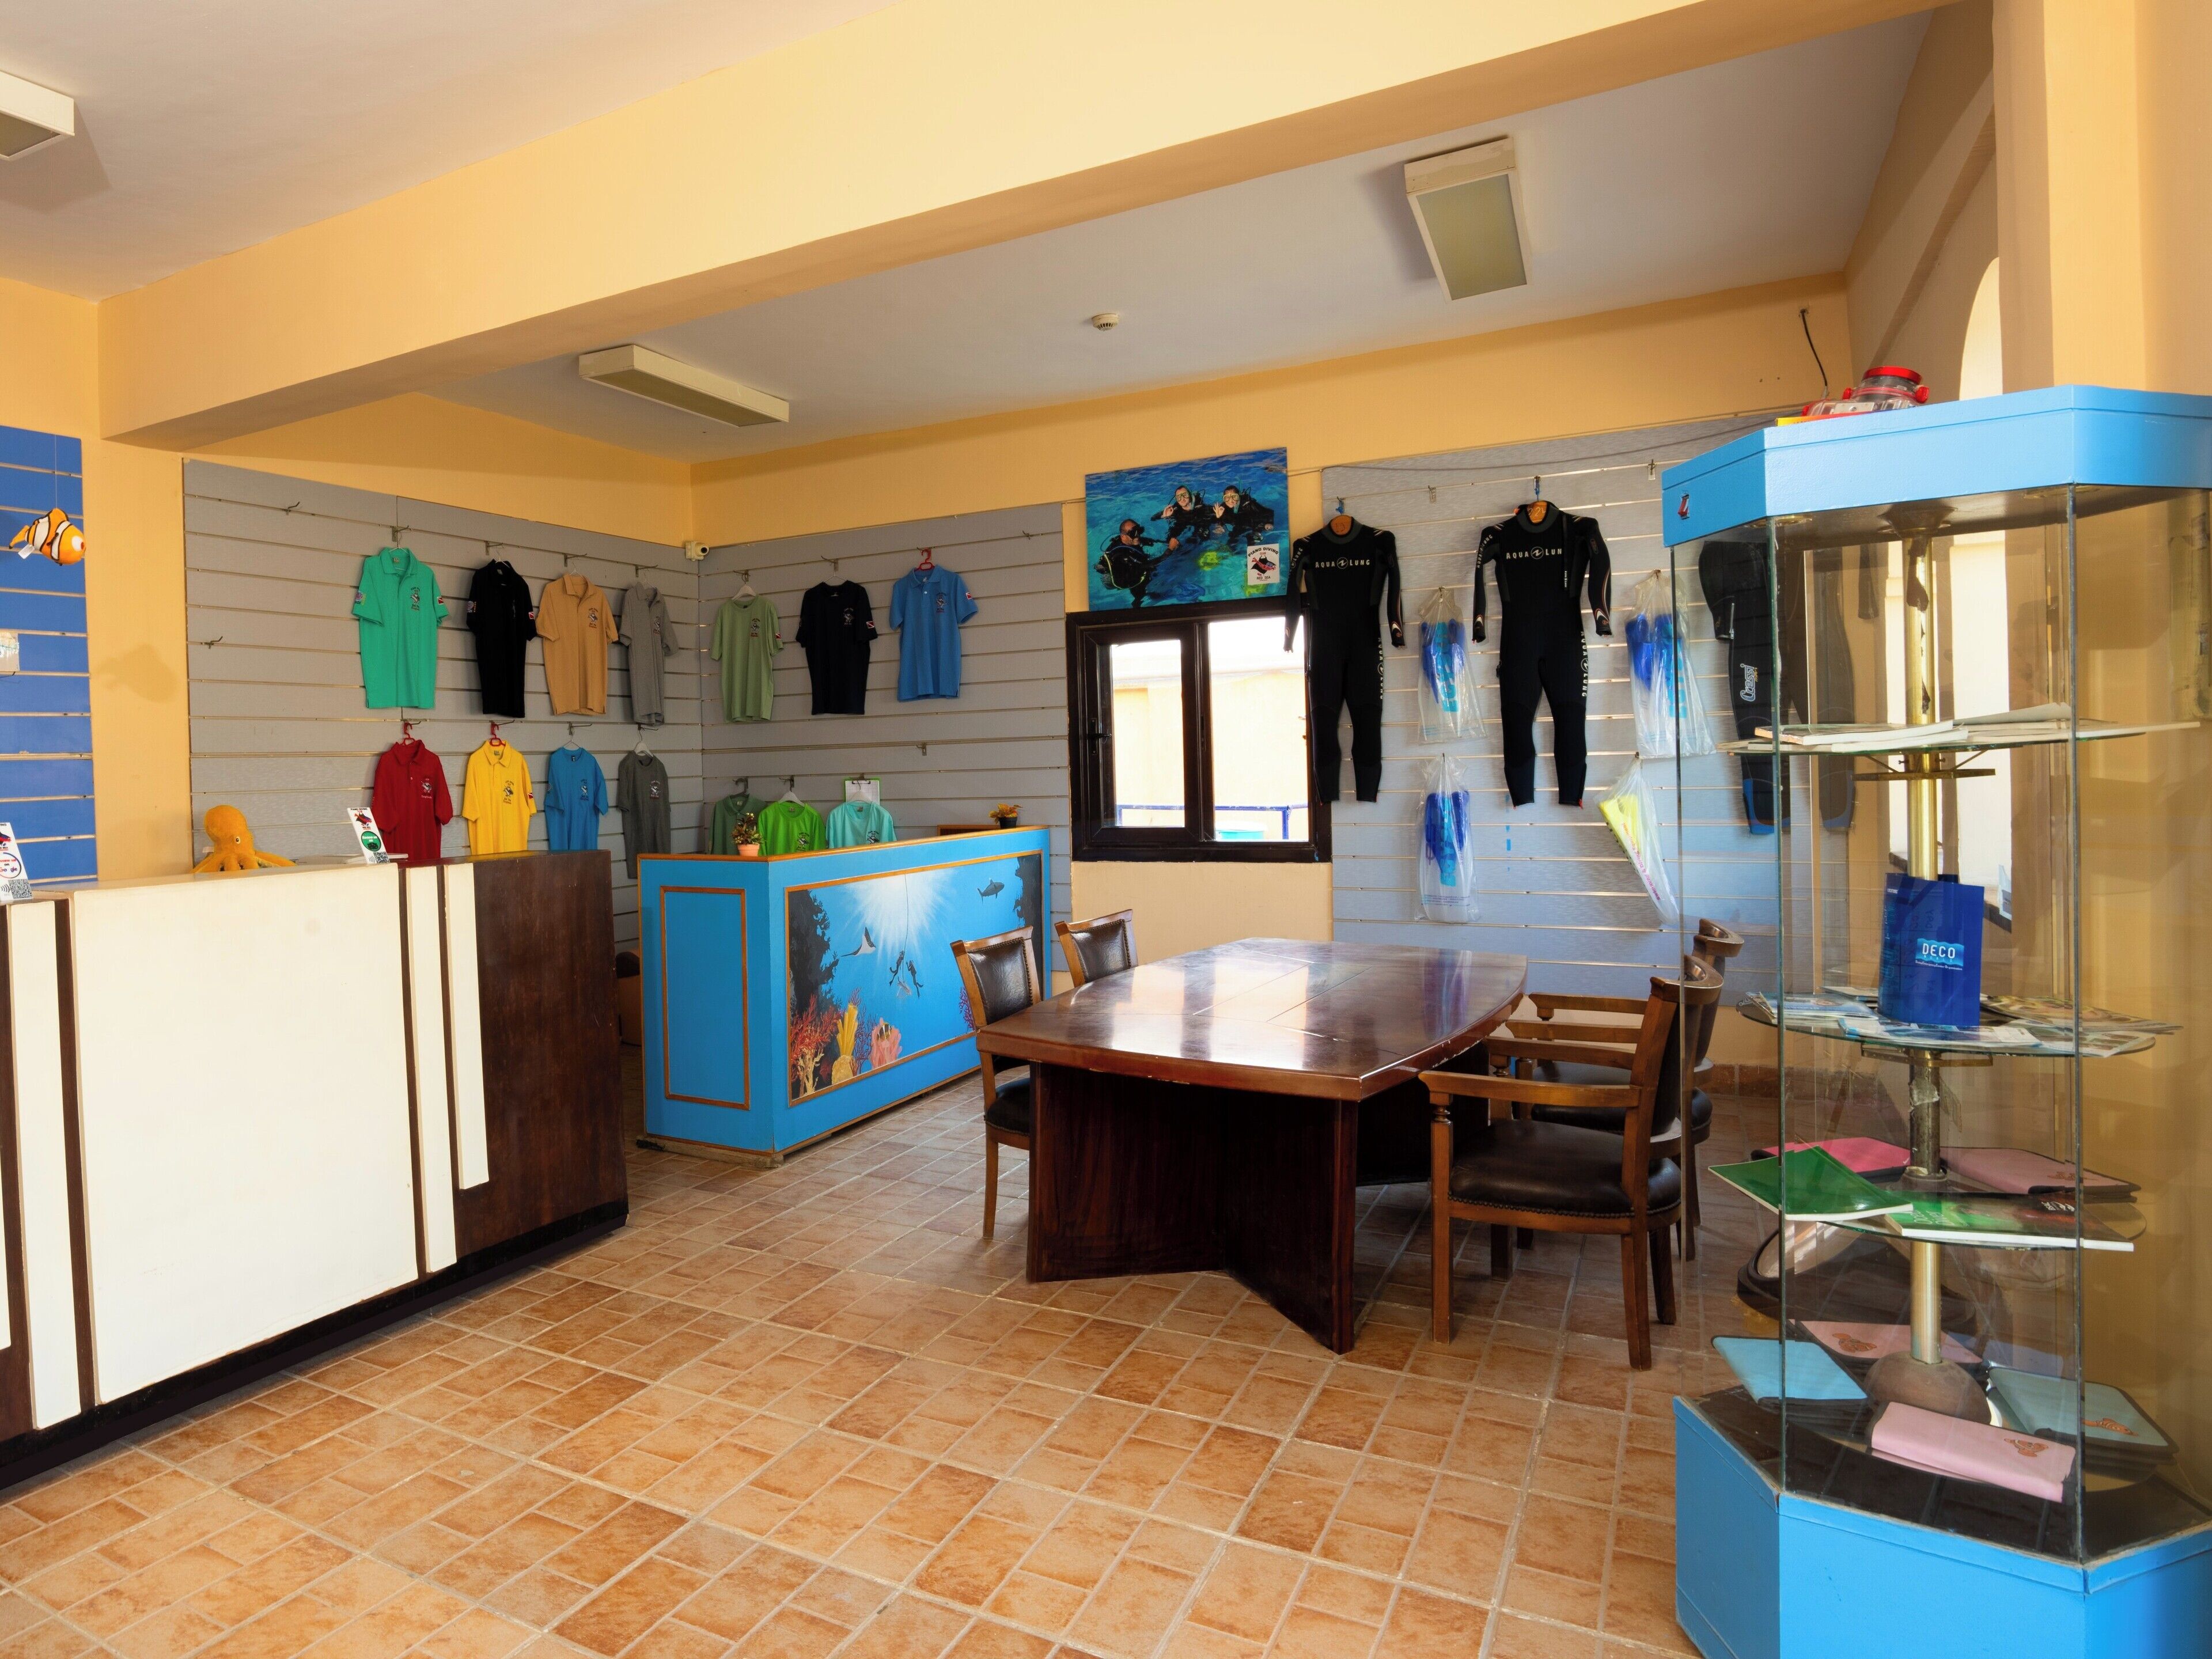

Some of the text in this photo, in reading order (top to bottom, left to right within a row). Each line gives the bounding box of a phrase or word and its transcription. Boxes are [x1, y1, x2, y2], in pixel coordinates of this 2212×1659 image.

[1248, 548, 1262, 557] PIANO
[1294, 547, 1303, 561] LUNG
[1506, 551, 1529, 559] AQUA
[1740, 663, 1756, 702] Cressi
[1644, 873, 1661, 901] Swimming
[1922, 943, 1956, 959] DECO
